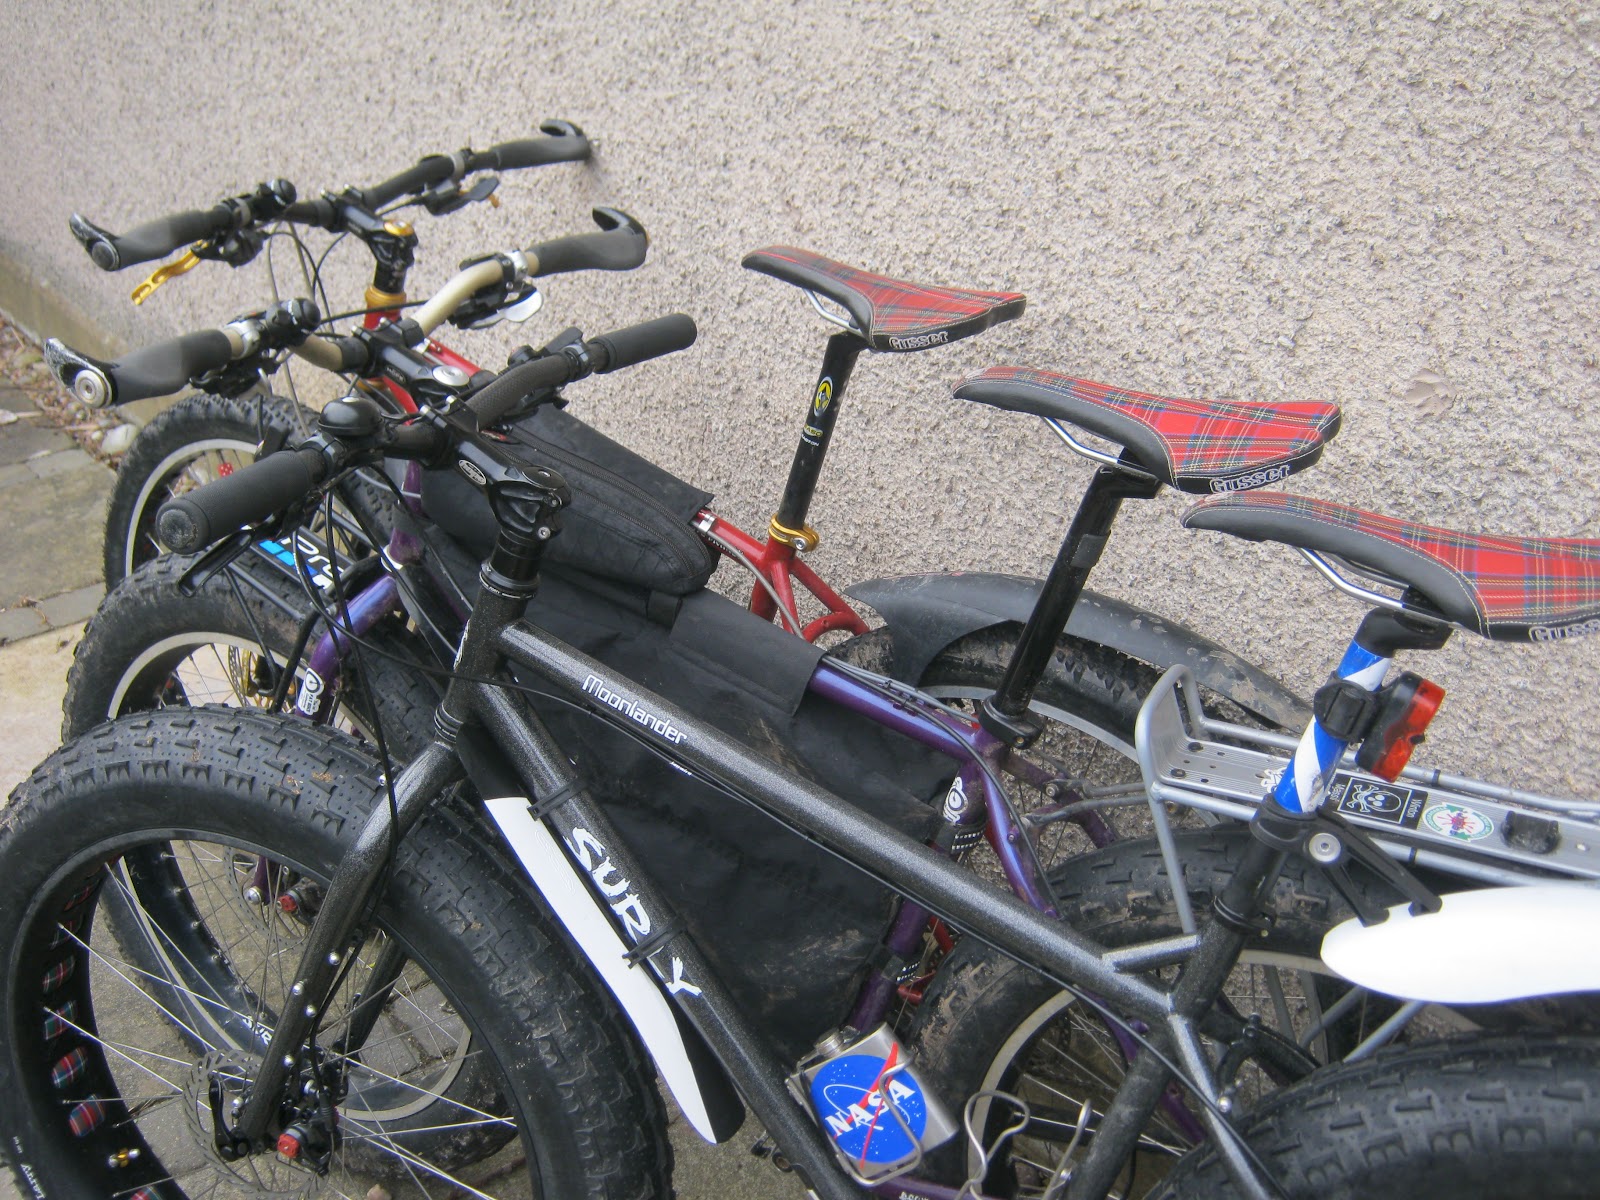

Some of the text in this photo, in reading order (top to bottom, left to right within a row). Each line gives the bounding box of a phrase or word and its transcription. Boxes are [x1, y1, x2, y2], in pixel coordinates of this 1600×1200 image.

[889, 331, 949, 350] Gusset
[1209, 464, 1290, 493] Gusset
[582, 674, 687, 744] Moonlander
[825, 1079, 916, 1137] NASA
